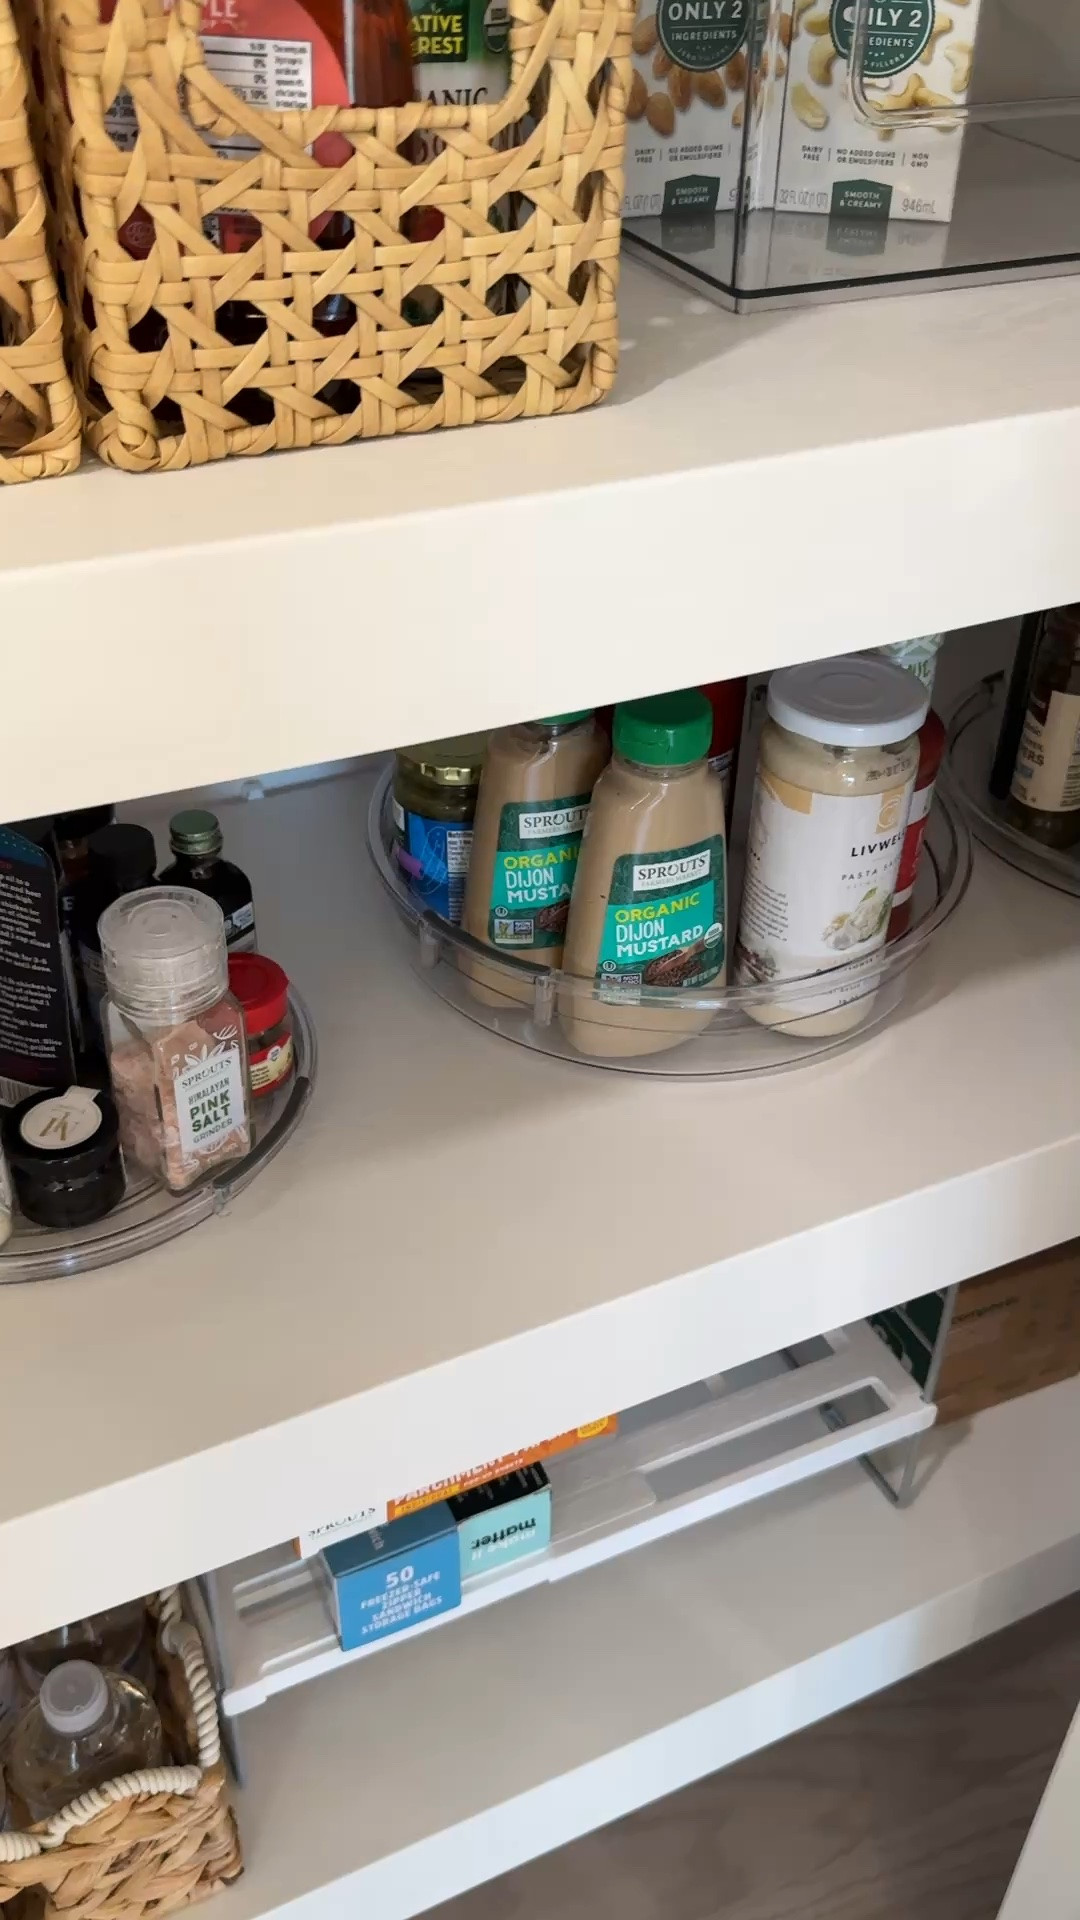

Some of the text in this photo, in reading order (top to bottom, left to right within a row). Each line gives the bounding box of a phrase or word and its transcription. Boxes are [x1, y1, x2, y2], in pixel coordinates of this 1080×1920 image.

[668, 1, 743, 20] ONLY 2
[908, 10, 922, 27] 2
[411, 14, 463, 33] ATIVE
[671, 30, 737, 41] INGREDIENTS
[802, 145, 823, 154] DAIRY
[803, 153, 820, 162] FREE
[849, 157, 894, 167] EMULSIFIERS
[911, 160, 929, 168] GMO
[844, 190, 880, 199] SMOOTH
[847, 201, 883, 209] CREAMY
[505, 867, 554, 889] DIJON
[638, 857, 706, 881] SPROUTS
[841, 868, 878, 881] PASTA
[507, 884, 572, 903] MUSTA
[615, 892, 700, 923] ORGANIC
[616, 918, 664, 943] DIJON
[616, 924, 704, 958] MUSTARD
[181, 1057, 233, 1089] SPROUTS
[188, 1077, 230, 1105] HIMALAYAN
[190, 1089, 230, 1120] PINK
[192, 1103, 231, 1133] SALT
[193, 1118, 233, 1144] GRINDER
[471, 1517, 537, 1550] matter.
[386, 1565, 414, 1588] 50
[360, 1571, 440, 1609] FREEZER-SAFE
[361, 1596, 443, 1634] STORAGE BAGS
[372, 1592, 432, 1622] SANDWICH
